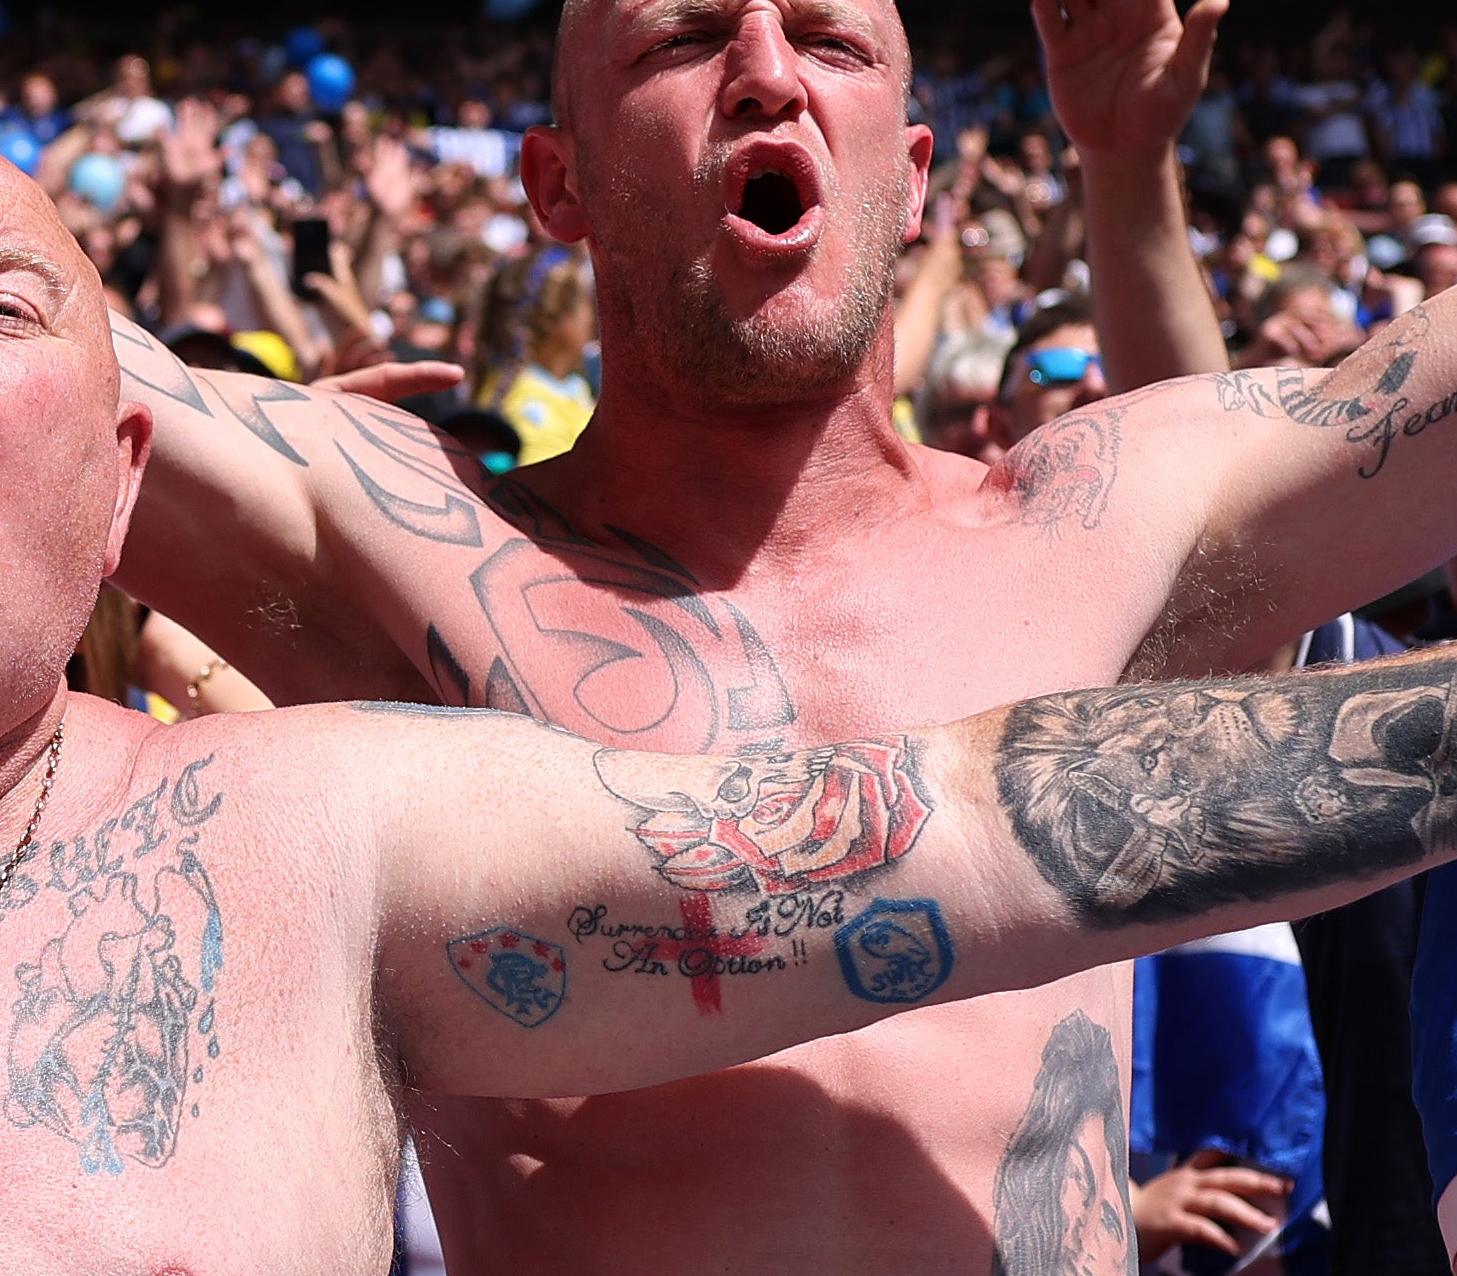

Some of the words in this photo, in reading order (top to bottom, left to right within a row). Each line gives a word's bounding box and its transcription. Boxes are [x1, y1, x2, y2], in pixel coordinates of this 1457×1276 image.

[775, 890, 844, 937] Not
[603, 940, 668, 976] An
[678, 947, 786, 982] Option
